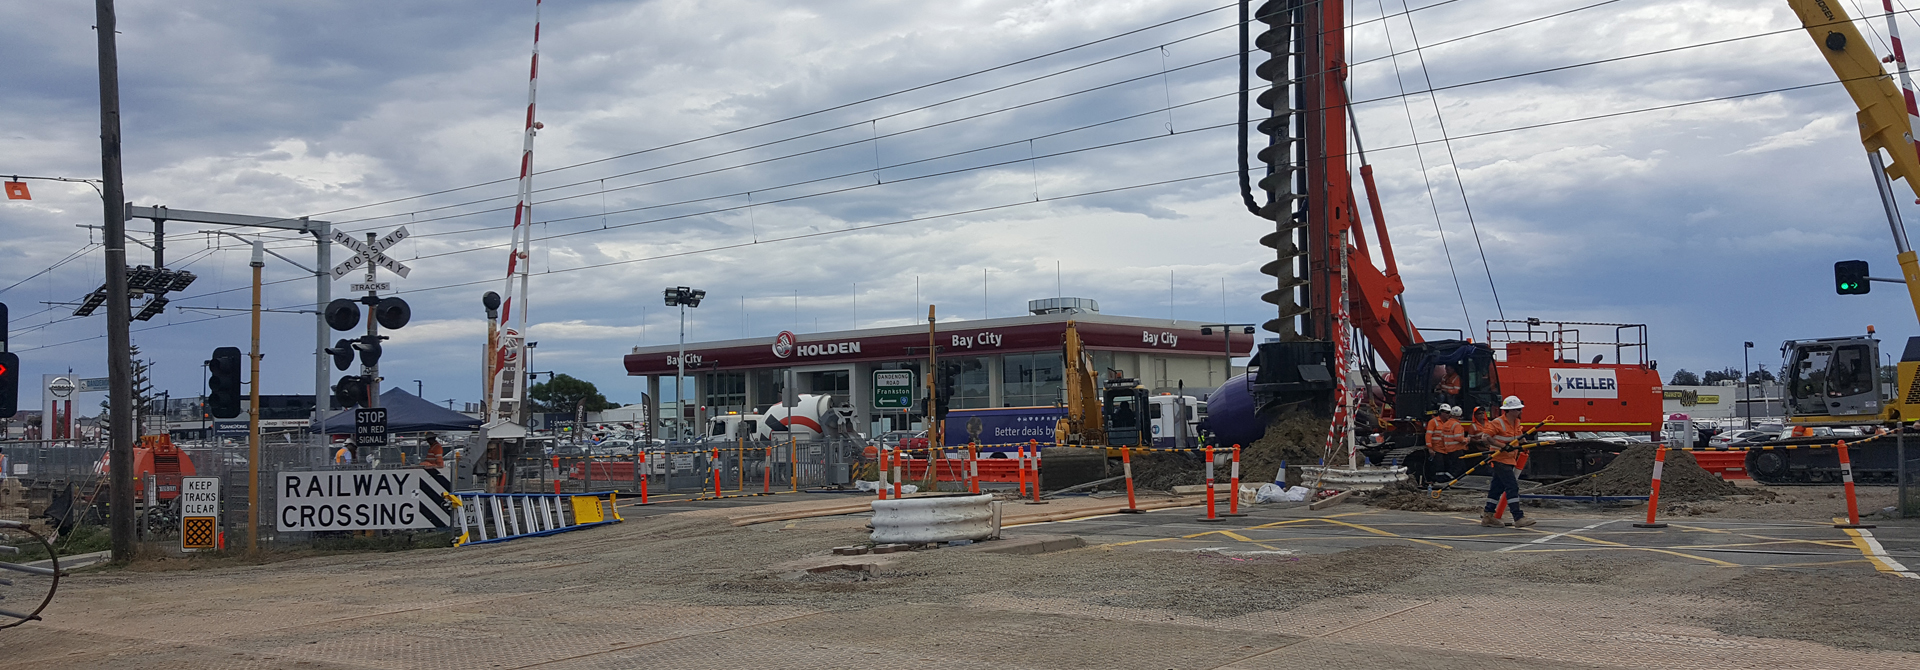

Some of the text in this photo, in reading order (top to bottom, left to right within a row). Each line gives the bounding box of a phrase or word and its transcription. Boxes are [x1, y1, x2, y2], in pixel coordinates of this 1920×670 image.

[335, 230, 403, 276] CROSSING
[366, 274, 373, 282] 2
[355, 283, 386, 291] TRACKS
[952, 332, 1002, 348] Bay City
[1142, 330, 1178, 347] Bay City
[796, 341, 861, 357] HOLDEN
[684, 353, 702, 366] City
[1565, 377, 1616, 391] KELLER
[357, 411, 385, 423] STOP
[358, 425, 385, 434] ON RED
[995, 425, 1056, 439] Better deals by
[359, 435, 385, 444] SIGNAL
[188, 481, 213, 490] KEEP
[285, 473, 410, 498] RAILWAY
[184, 492, 216, 502] TRACKS
[185, 504, 215, 514] CLEAR
[282, 502, 415, 528] CROSSING
